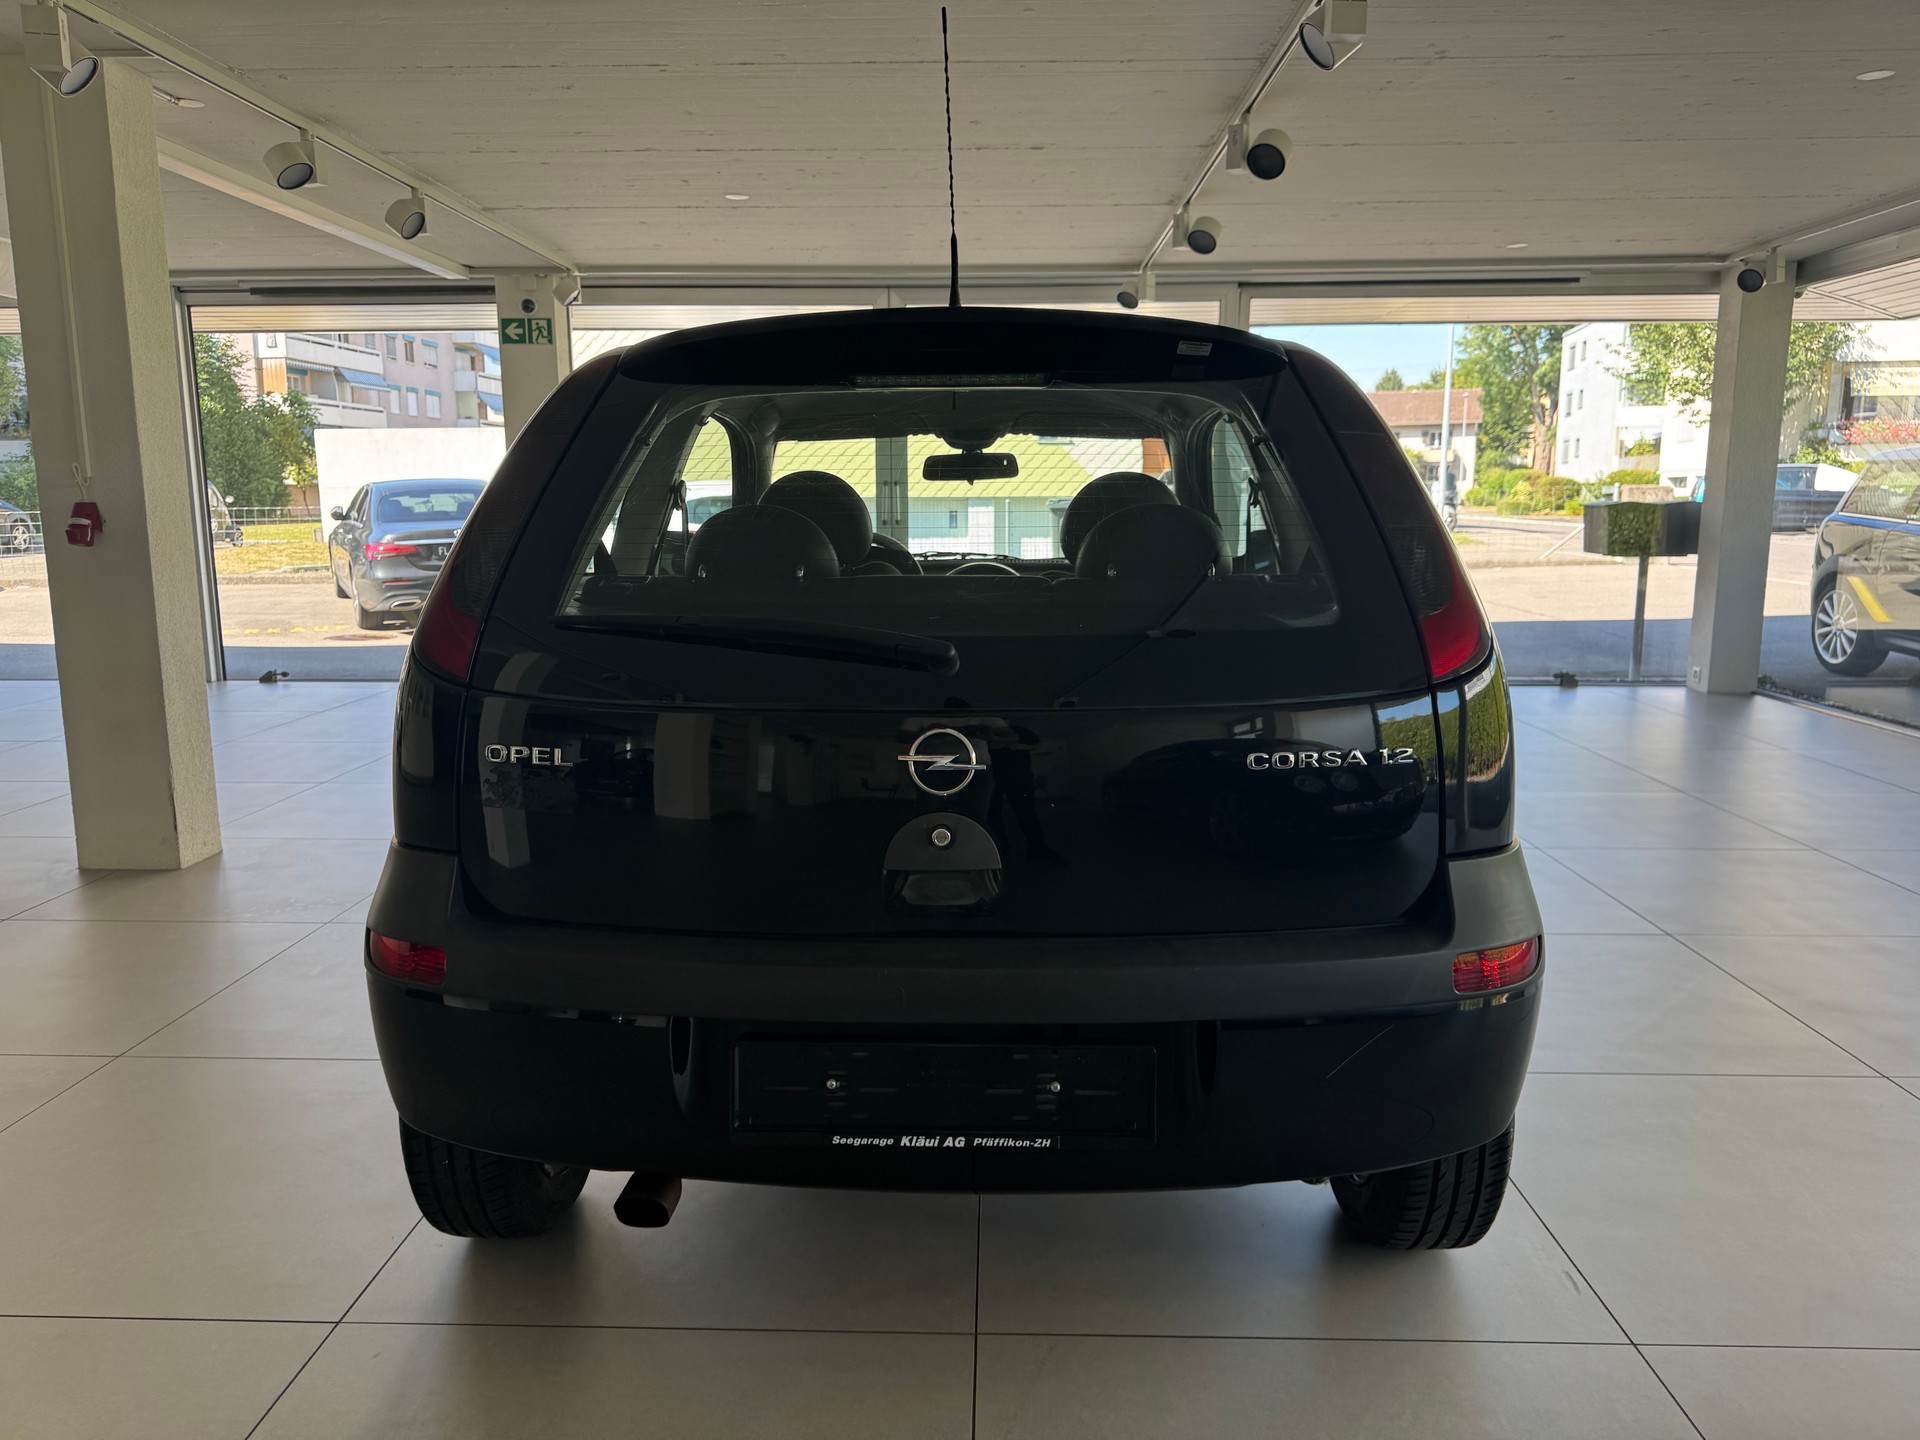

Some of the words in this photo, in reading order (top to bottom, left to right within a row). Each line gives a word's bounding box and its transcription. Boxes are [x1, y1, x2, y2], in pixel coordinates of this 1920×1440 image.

[223, 624, 349, 635] ERKAUF
[485, 744, 573, 767] OPEL
[1246, 749, 1368, 770] CORSA
[832, 1136, 894, 1146] Seegarage
[900, 1136, 940, 1147] Kläui
[943, 1136, 965, 1147] AG
[973, 1138, 1051, 1147] Pfäffikon-ZH
